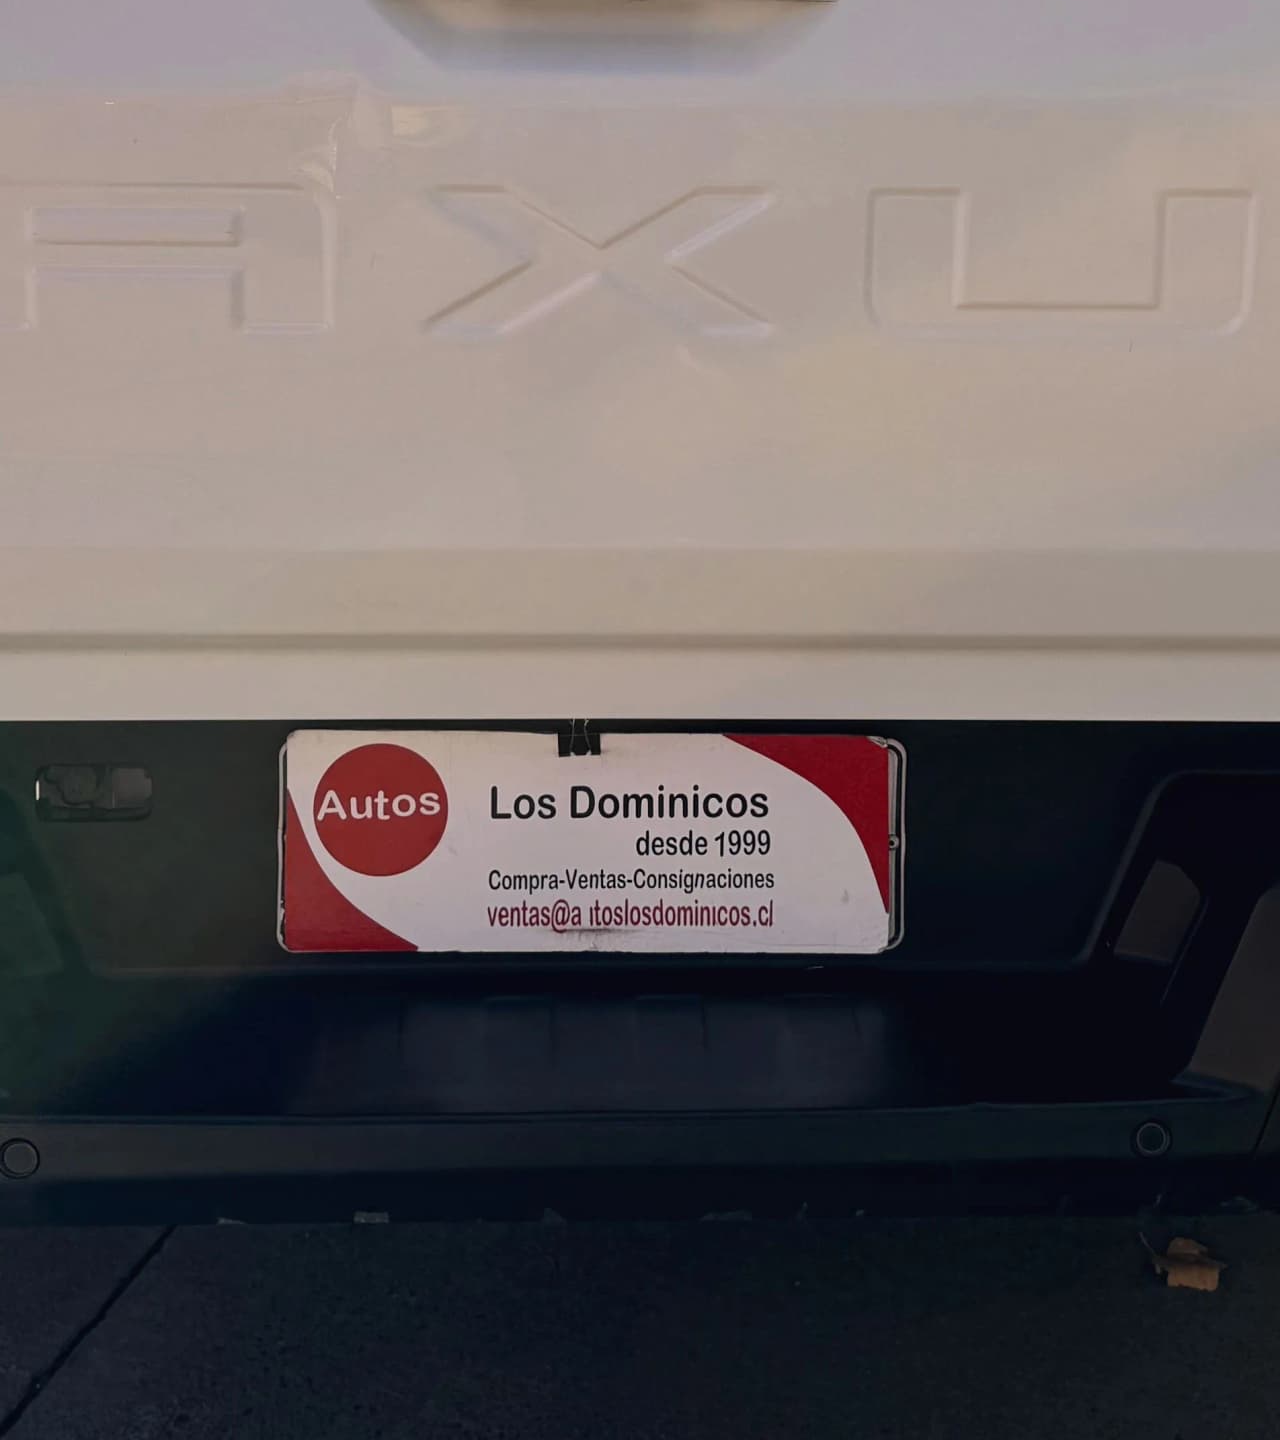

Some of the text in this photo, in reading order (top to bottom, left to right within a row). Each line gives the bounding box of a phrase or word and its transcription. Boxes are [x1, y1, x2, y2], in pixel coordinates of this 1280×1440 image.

[317, 784, 770, 821] Autos Los Dominicos
[636, 829, 771, 858] desde 1999
[488, 868, 775, 895] Compra-Ventas-Consignaciones
